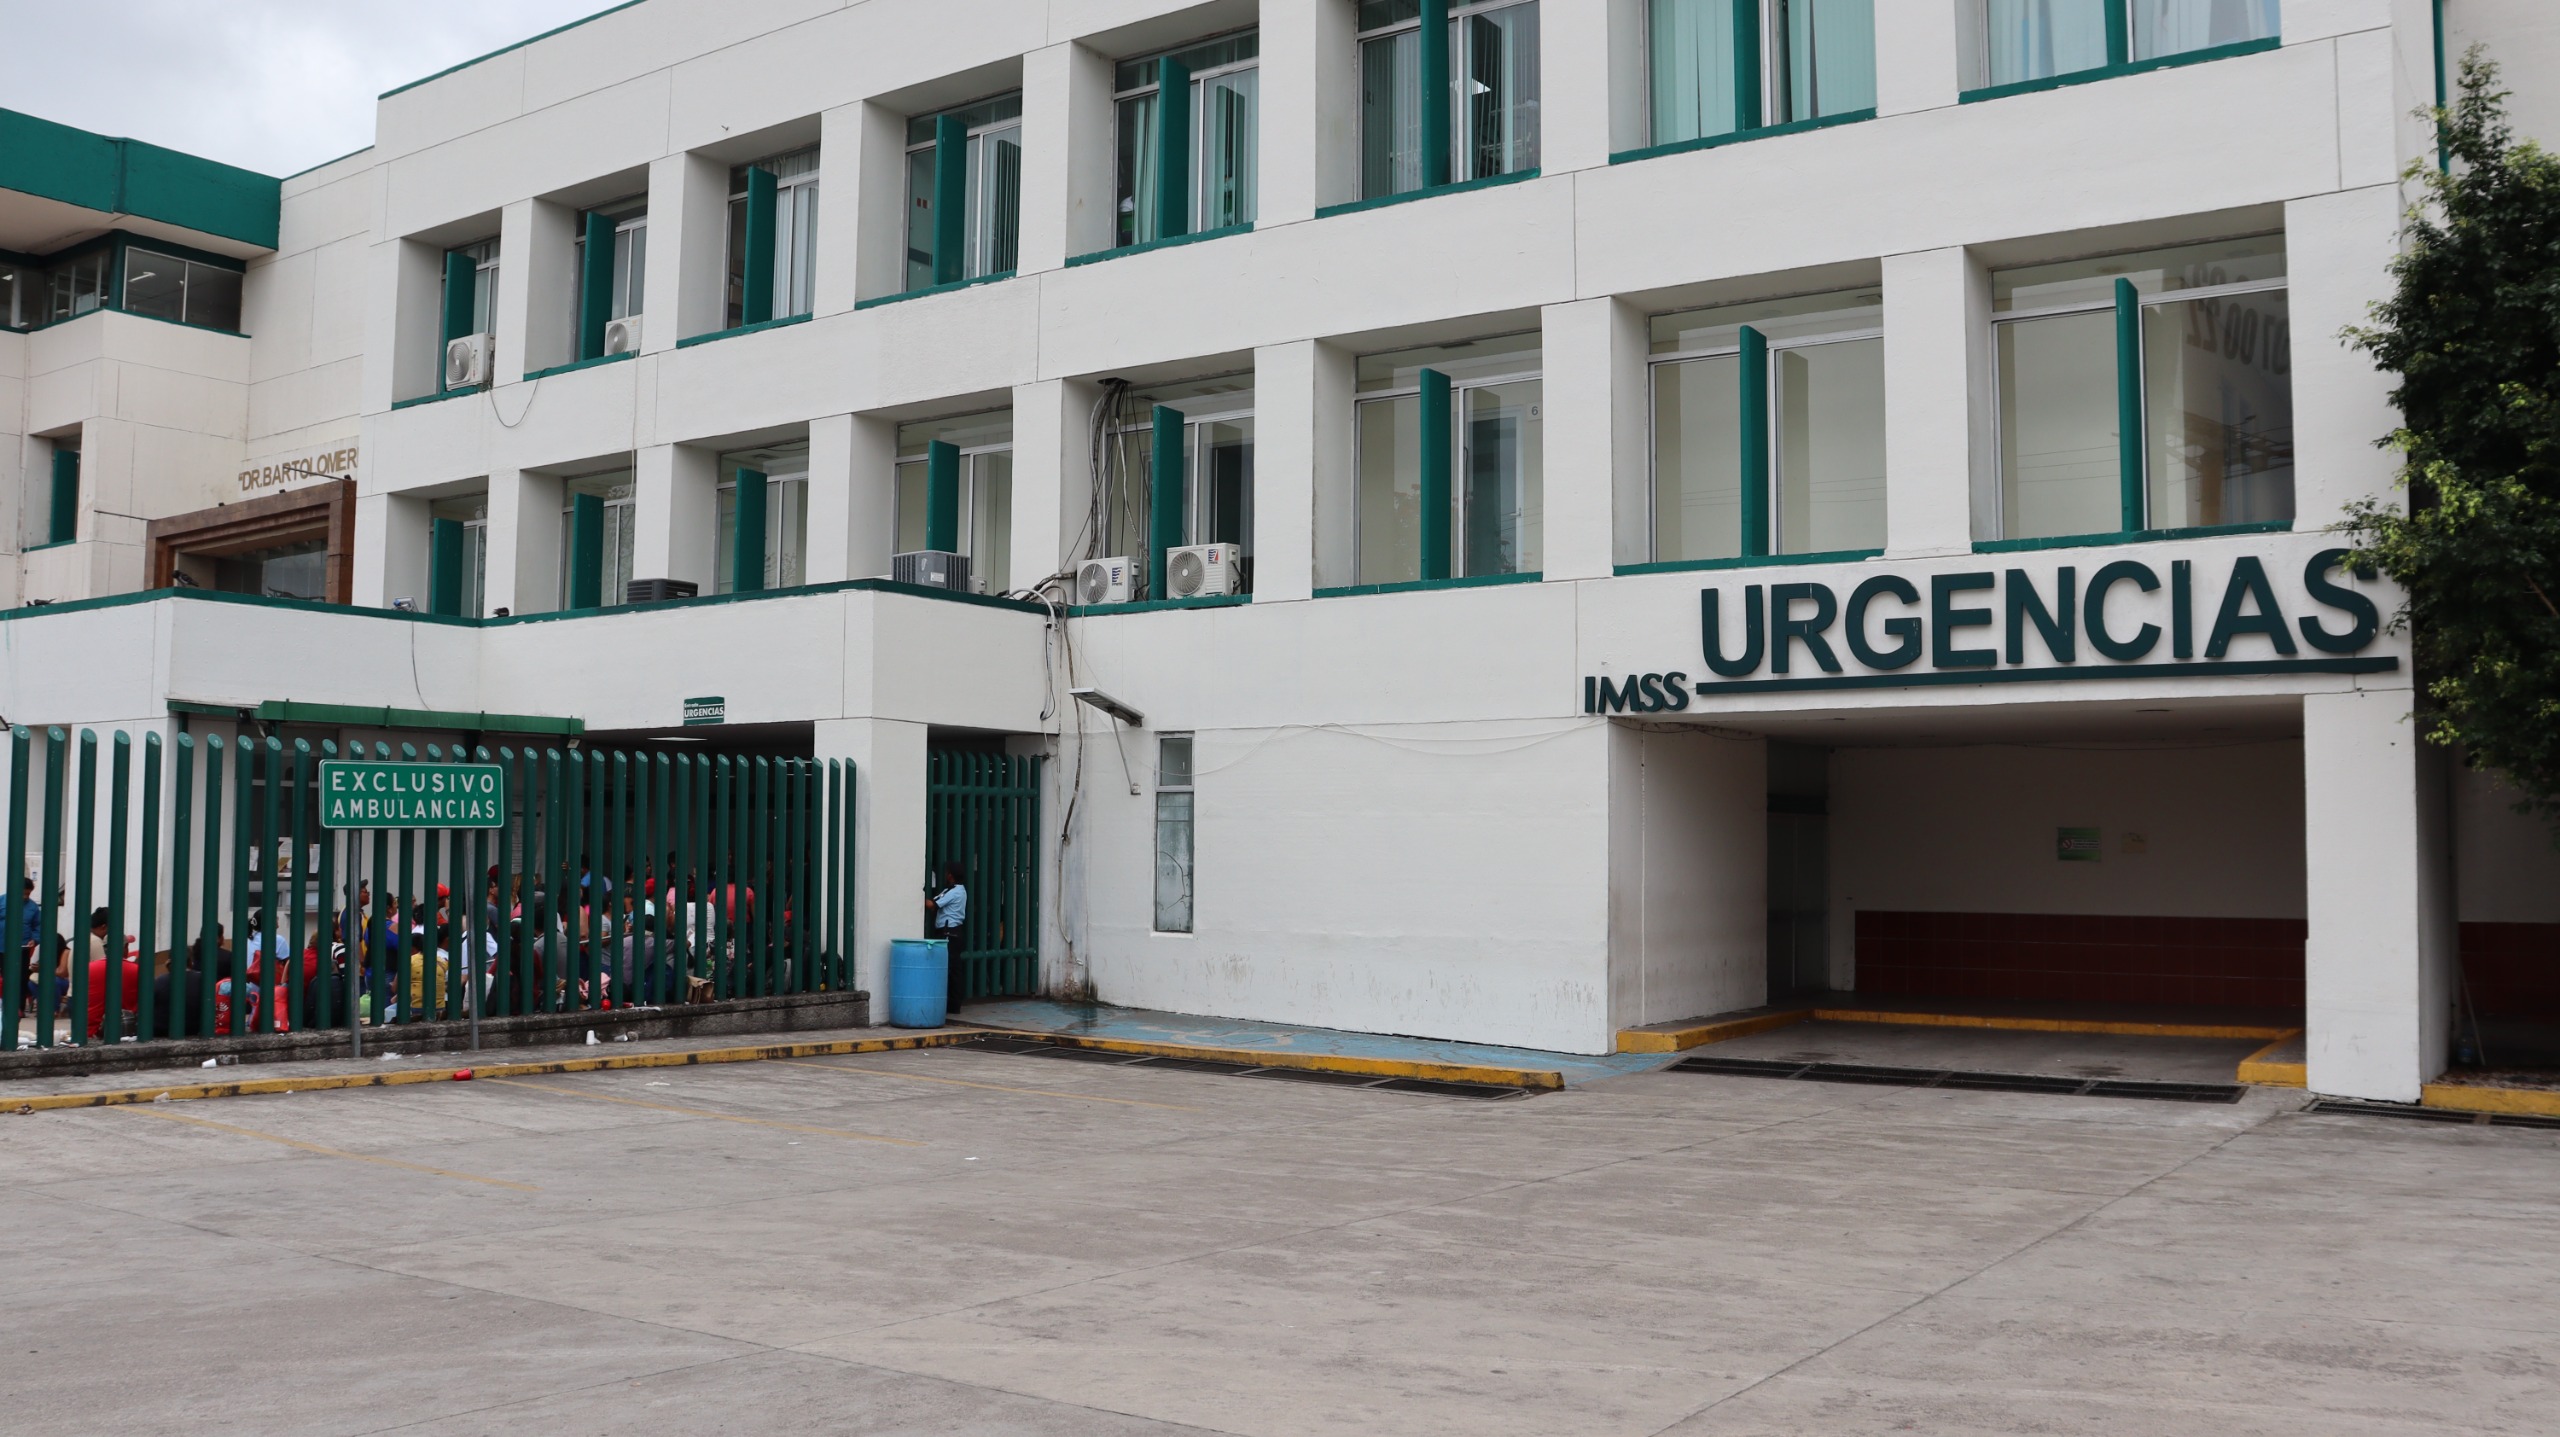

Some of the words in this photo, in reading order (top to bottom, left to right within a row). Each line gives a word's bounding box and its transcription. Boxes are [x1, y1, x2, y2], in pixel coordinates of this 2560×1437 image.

[1531, 405, 1539, 416] 6
[1701, 548, 2379, 678] URGENCIAS
[1584, 671, 1690, 714] IMSS
[684, 706, 724, 717] URGENCIAS
[332, 771, 494, 794] EXCLUSIVO
[332, 798, 496, 819] AMBULANCIAS
